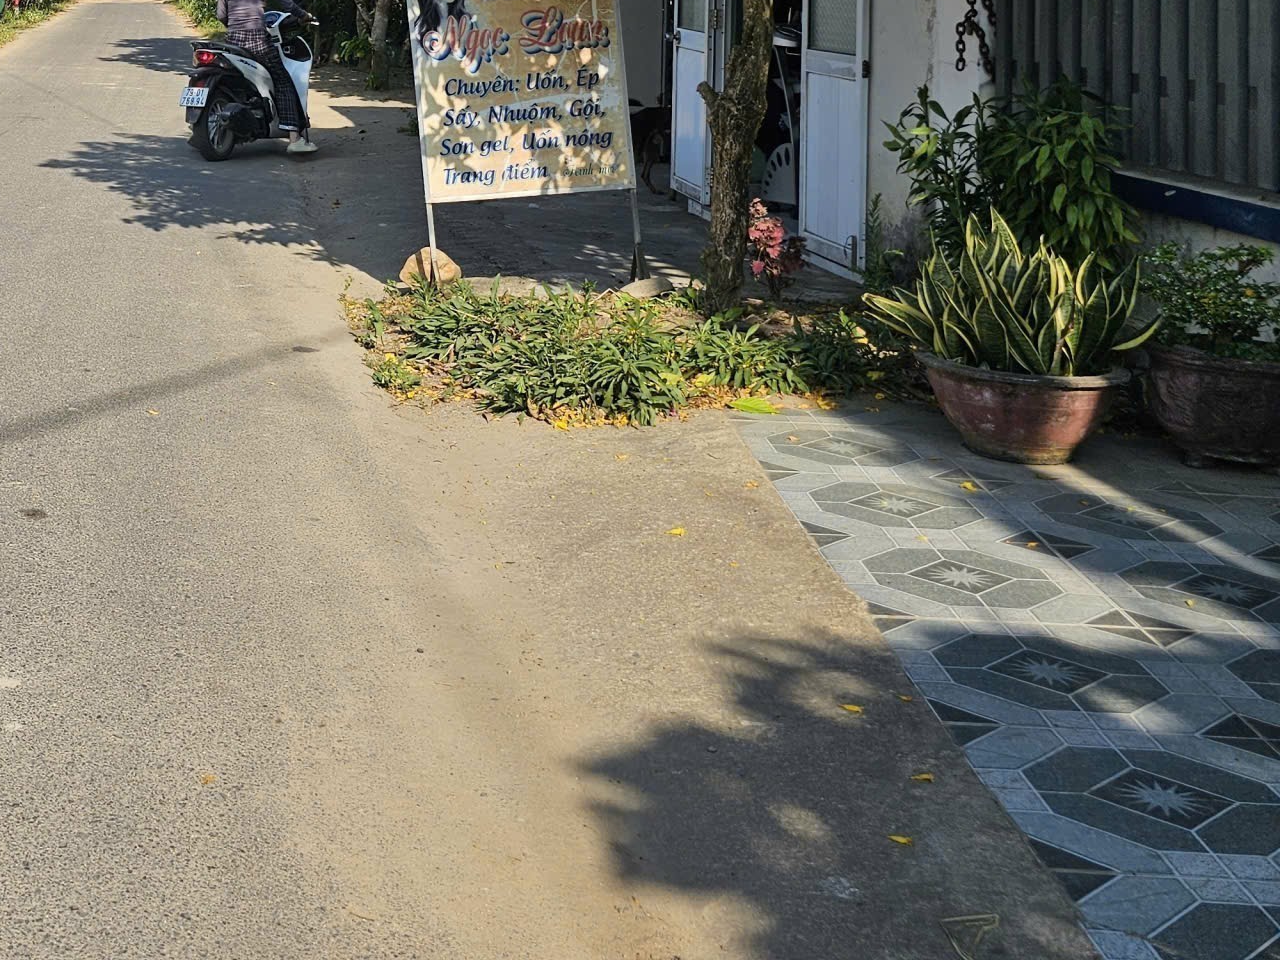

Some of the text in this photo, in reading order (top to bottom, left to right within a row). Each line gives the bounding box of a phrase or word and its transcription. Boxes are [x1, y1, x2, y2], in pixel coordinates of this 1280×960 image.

[444, 65, 600, 98] Chuyên: Uốn, Ép
[443, 98, 606, 129] Sấy, Nhuộm, Gội,
[439, 128, 613, 157] Sơn gel, Uốn nóng
[443, 158, 549, 186] Trang điểm
